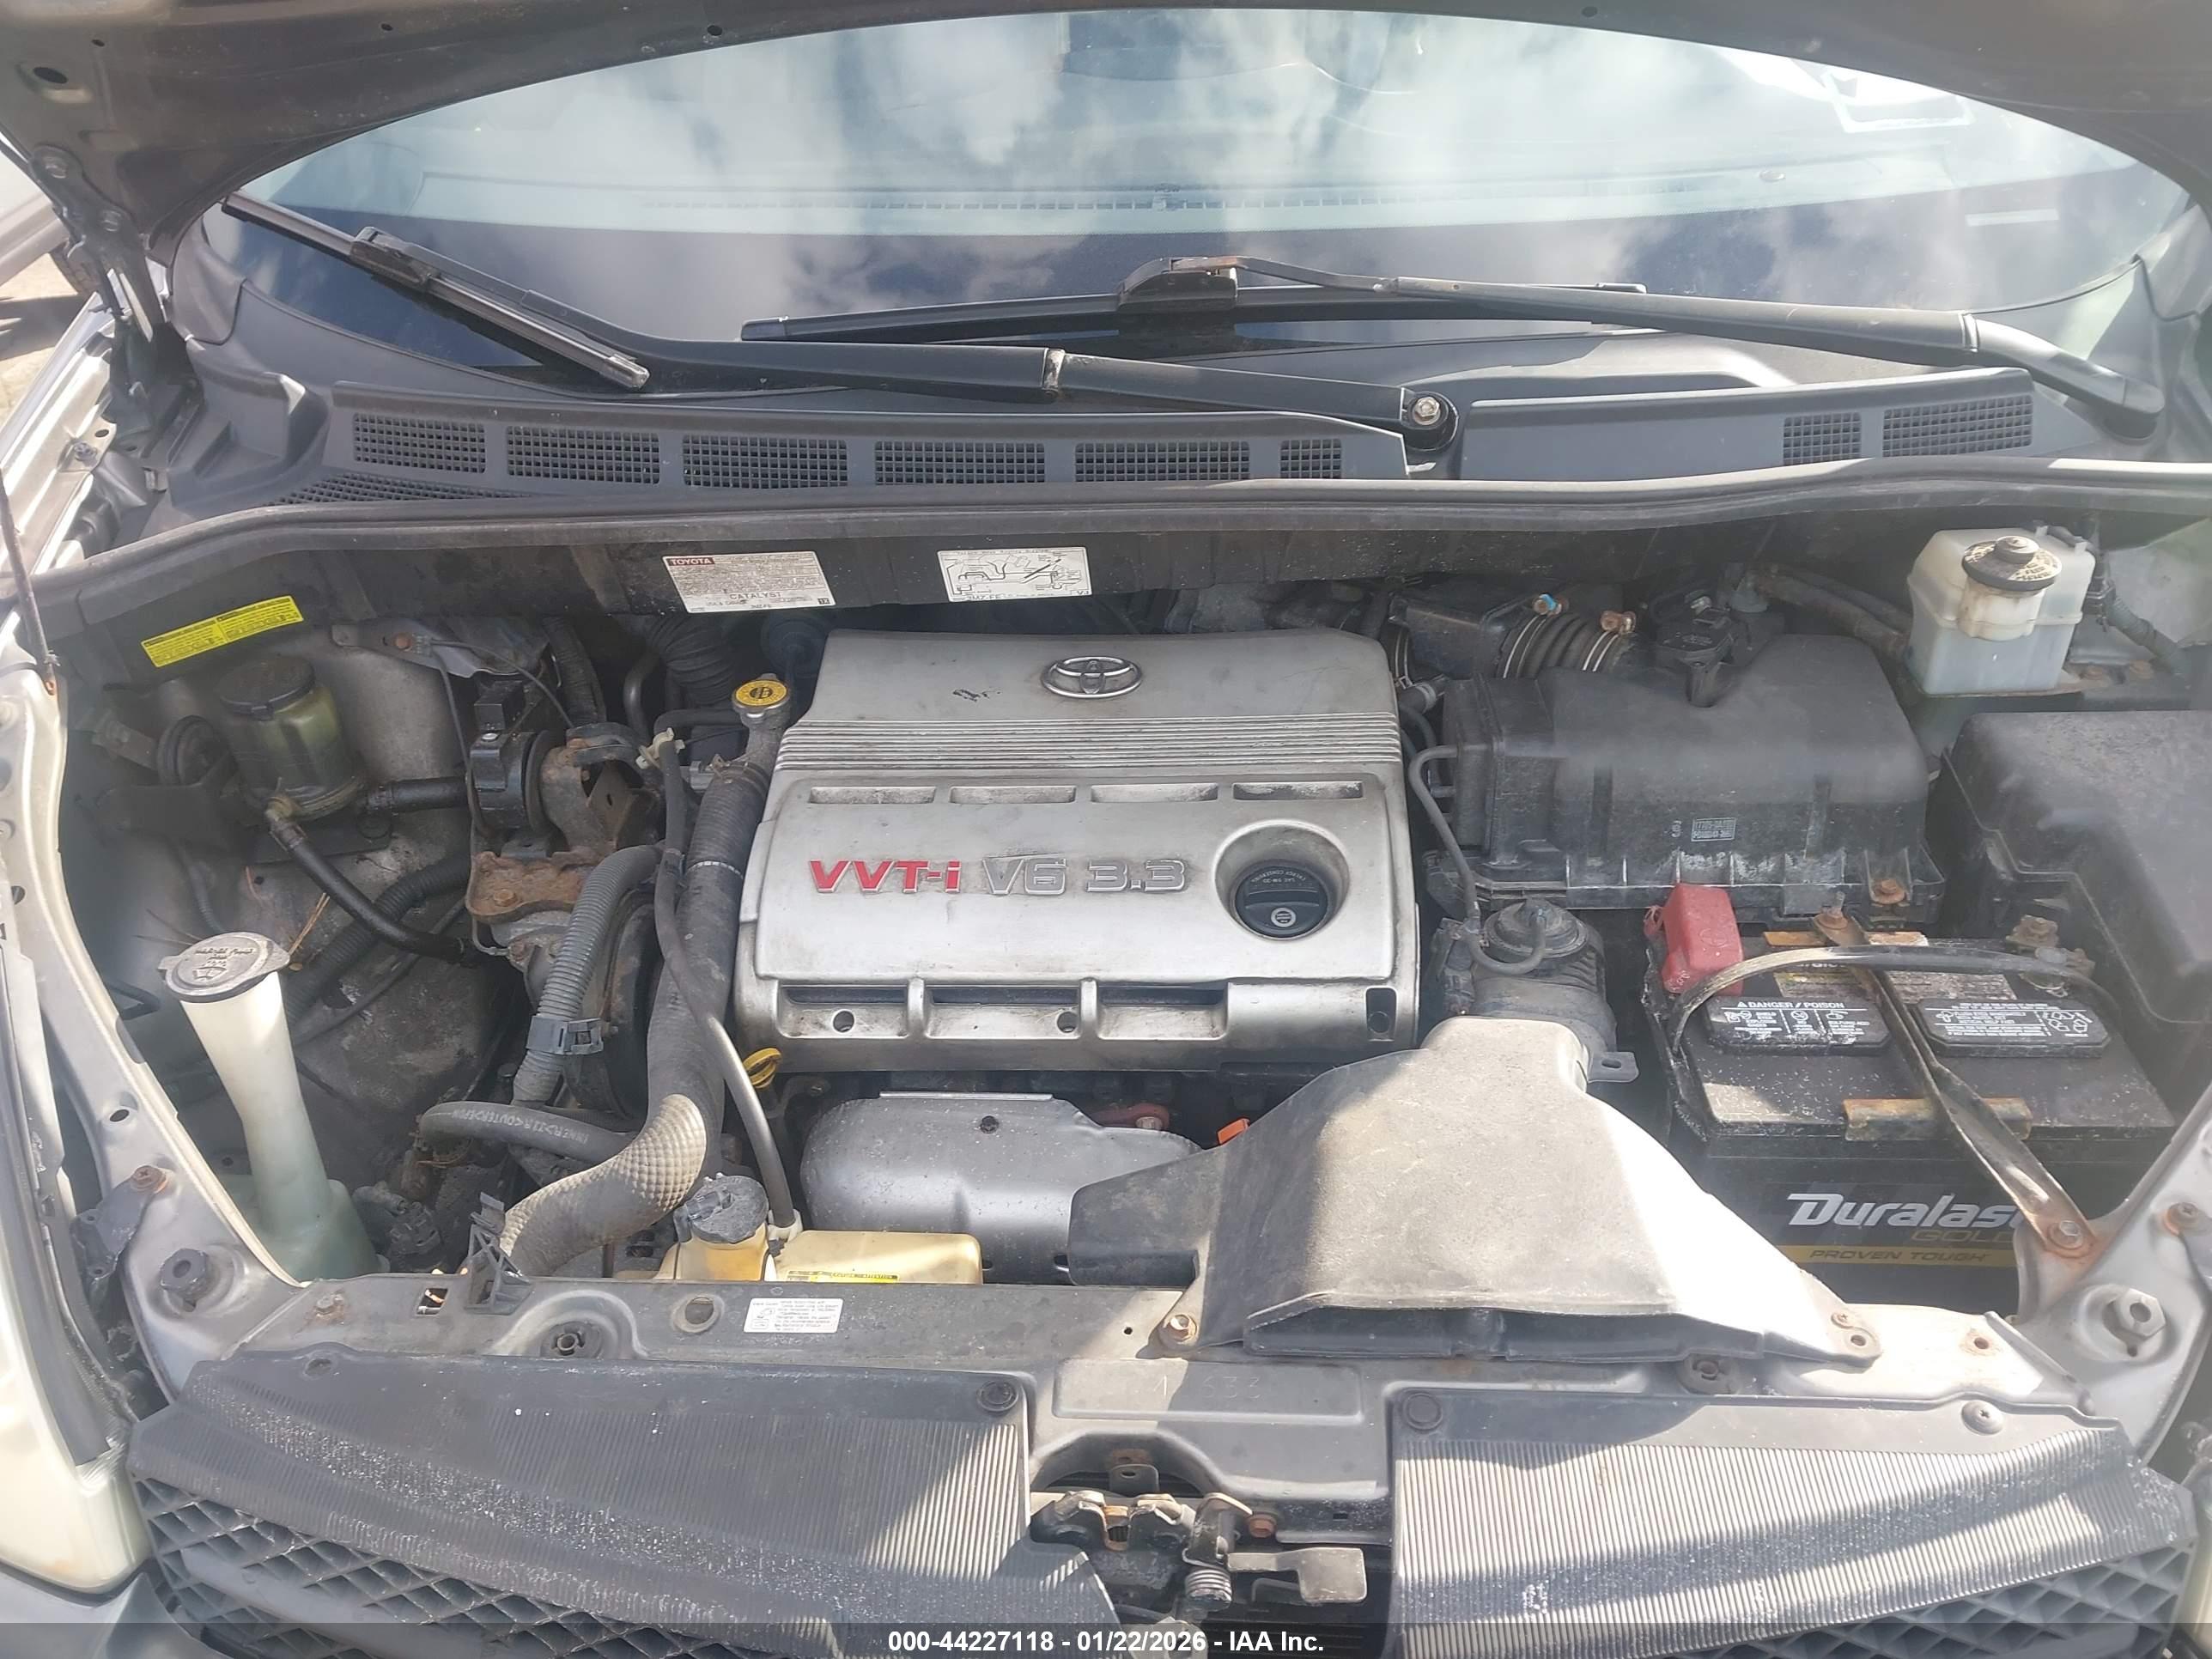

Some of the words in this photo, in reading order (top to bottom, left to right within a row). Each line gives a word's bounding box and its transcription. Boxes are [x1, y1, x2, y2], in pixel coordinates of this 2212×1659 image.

[730, 591, 783, 599] CATALYST
[810, 860, 962, 893] VVT-i
[982, 859, 1066, 895] V6
[1086, 860, 1185, 892] 3.3
[1809, 1249, 1903, 1260] PROVEN
[1911, 1251, 1984, 1261] TOUGH
